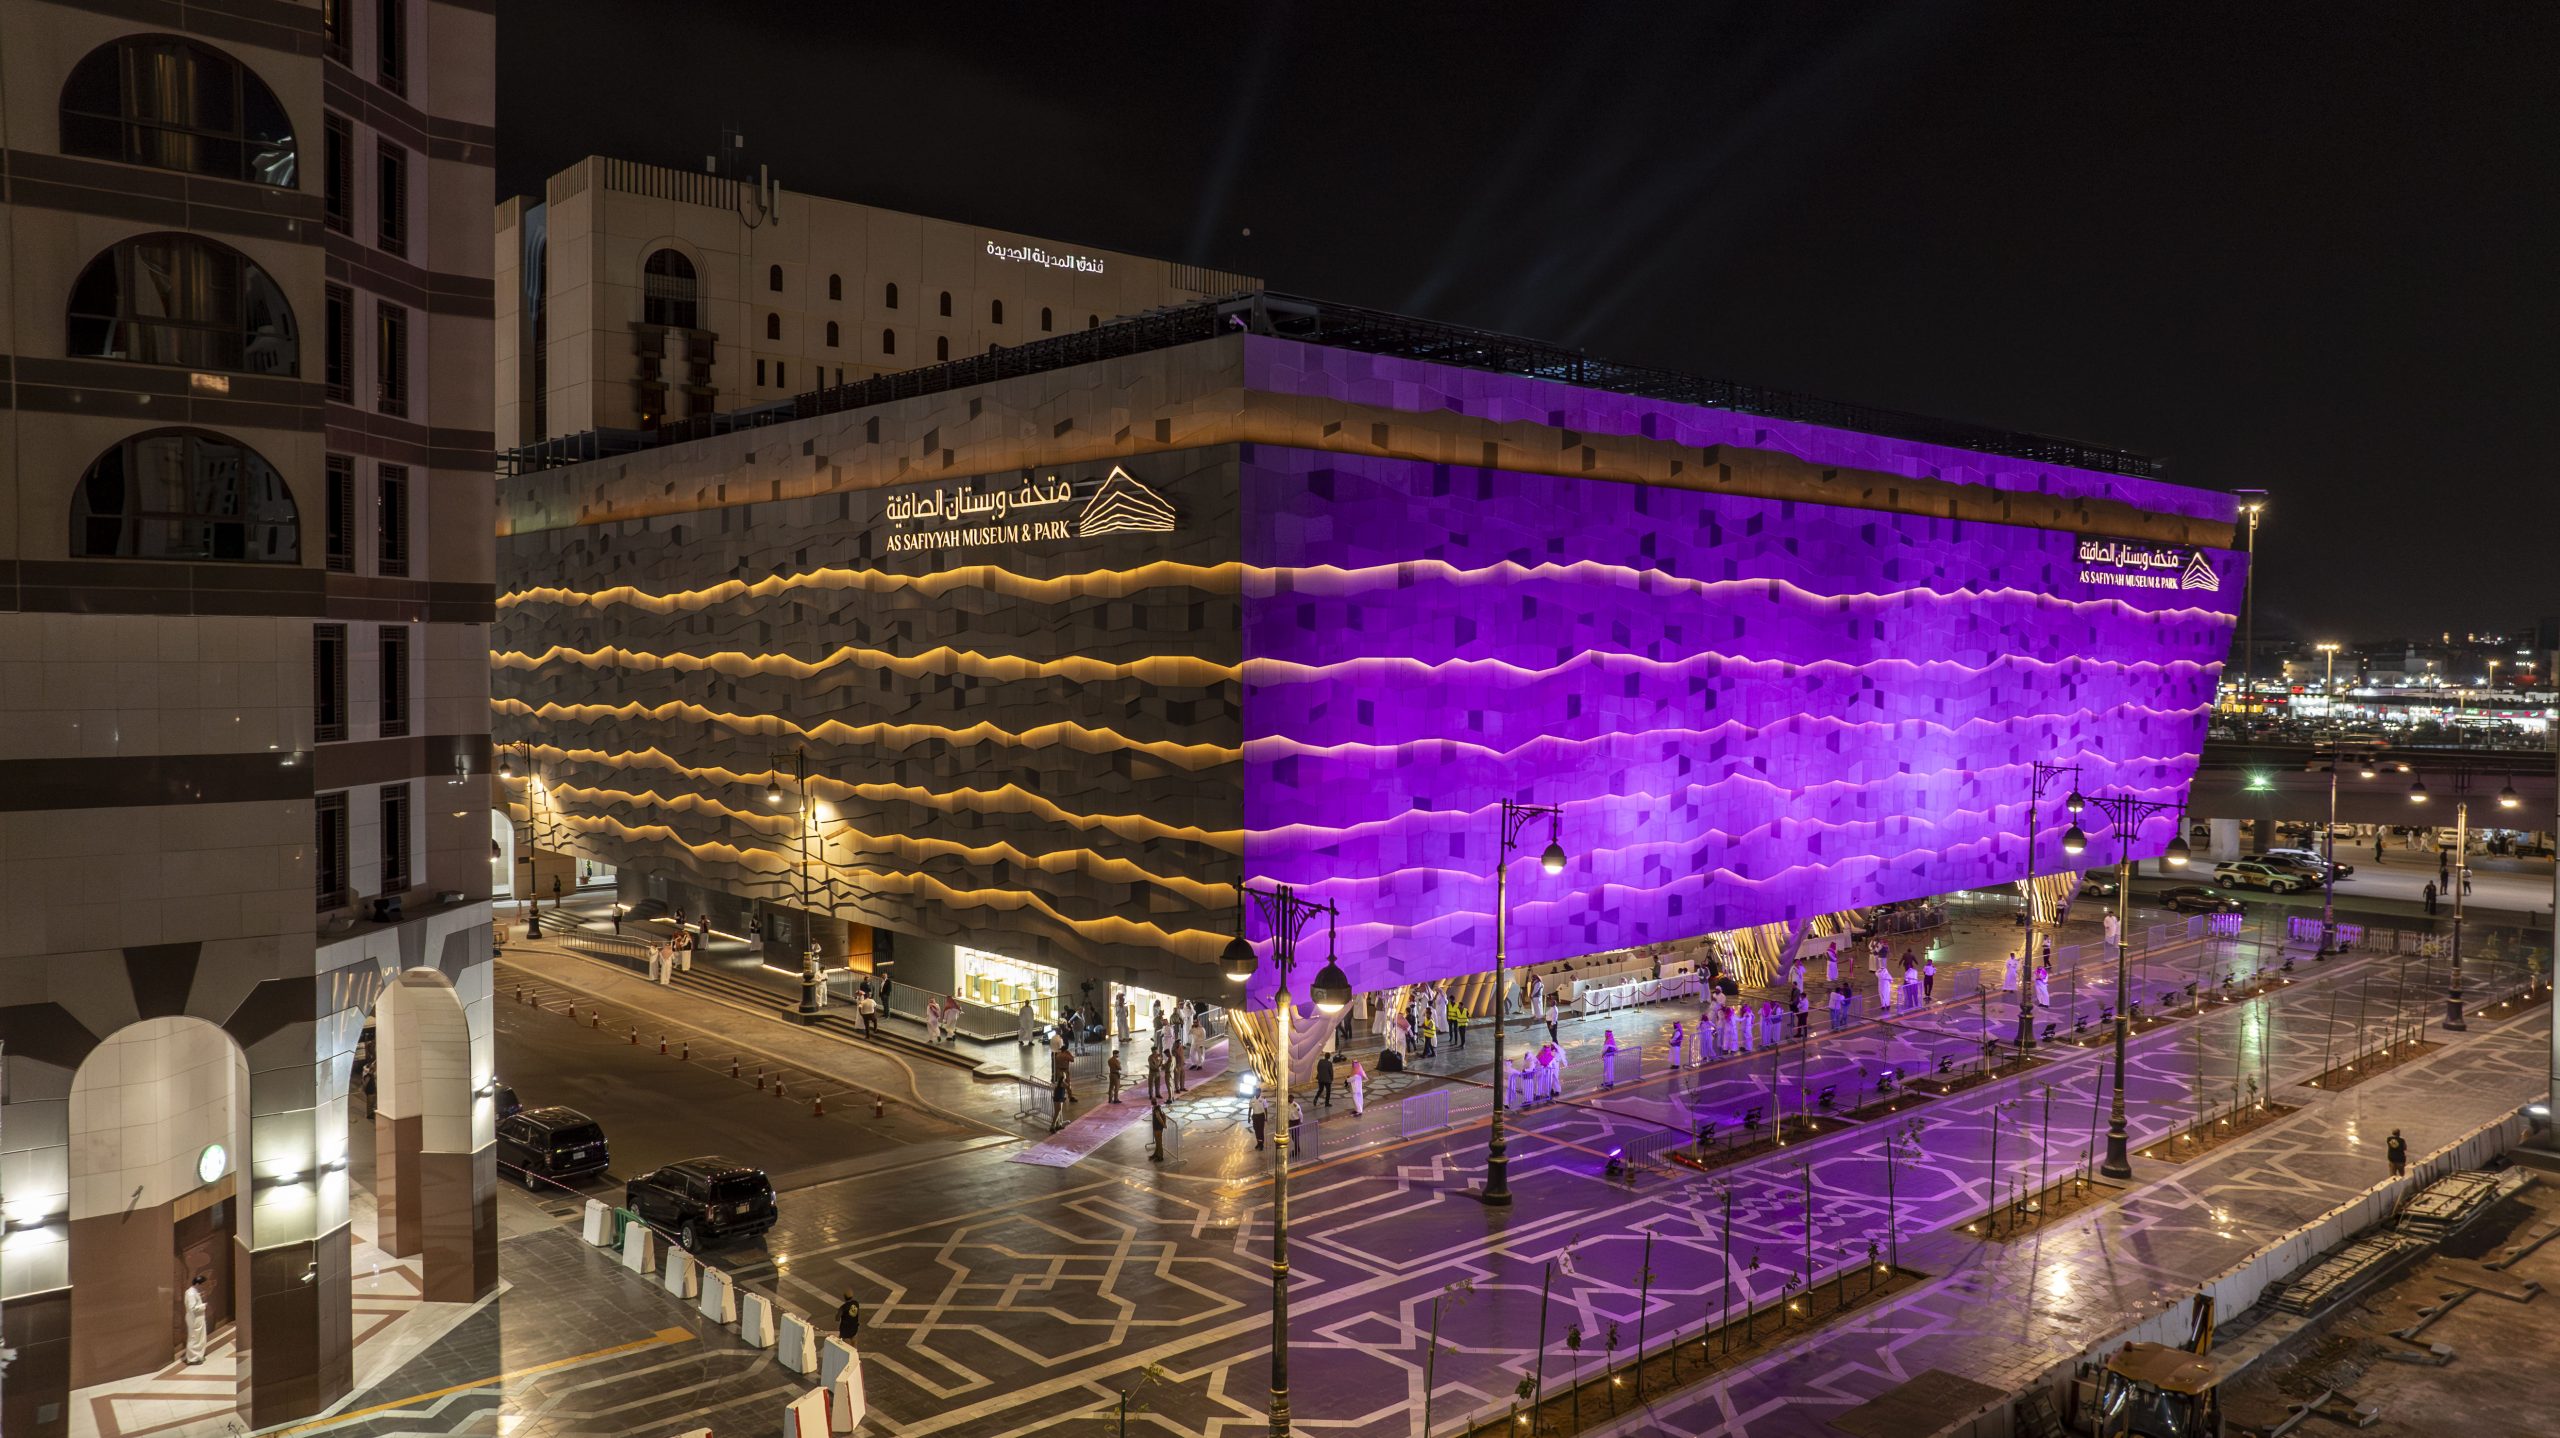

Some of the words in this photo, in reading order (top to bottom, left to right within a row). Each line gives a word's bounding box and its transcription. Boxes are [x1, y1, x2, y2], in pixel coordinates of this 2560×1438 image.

[986, 240, 1031, 262] الجديدة
[1032, 247, 1074, 268] المدينة
[1076, 256, 1104, 274] فندق
[1009, 475, 1071, 508] متحف
[945, 486, 1006, 521] وبستان
[886, 534, 902, 552] AS
[903, 529, 960, 551] SAFIYYAH
[962, 524, 1019, 547] MUSEUM
[1021, 523, 1032, 542] &
[1034, 520, 1071, 541] PARK
[2115, 544, 2150, 571] وبستان
[2149, 549, 2179, 568] متحف
[2079, 570, 2090, 583] AS
[2090, 571, 2125, 586] SAFIYYAH
[2125, 575, 2155, 588] MUSEUM
[2155, 576, 2161, 589] &
[2161, 577, 2179, 590] PARK
